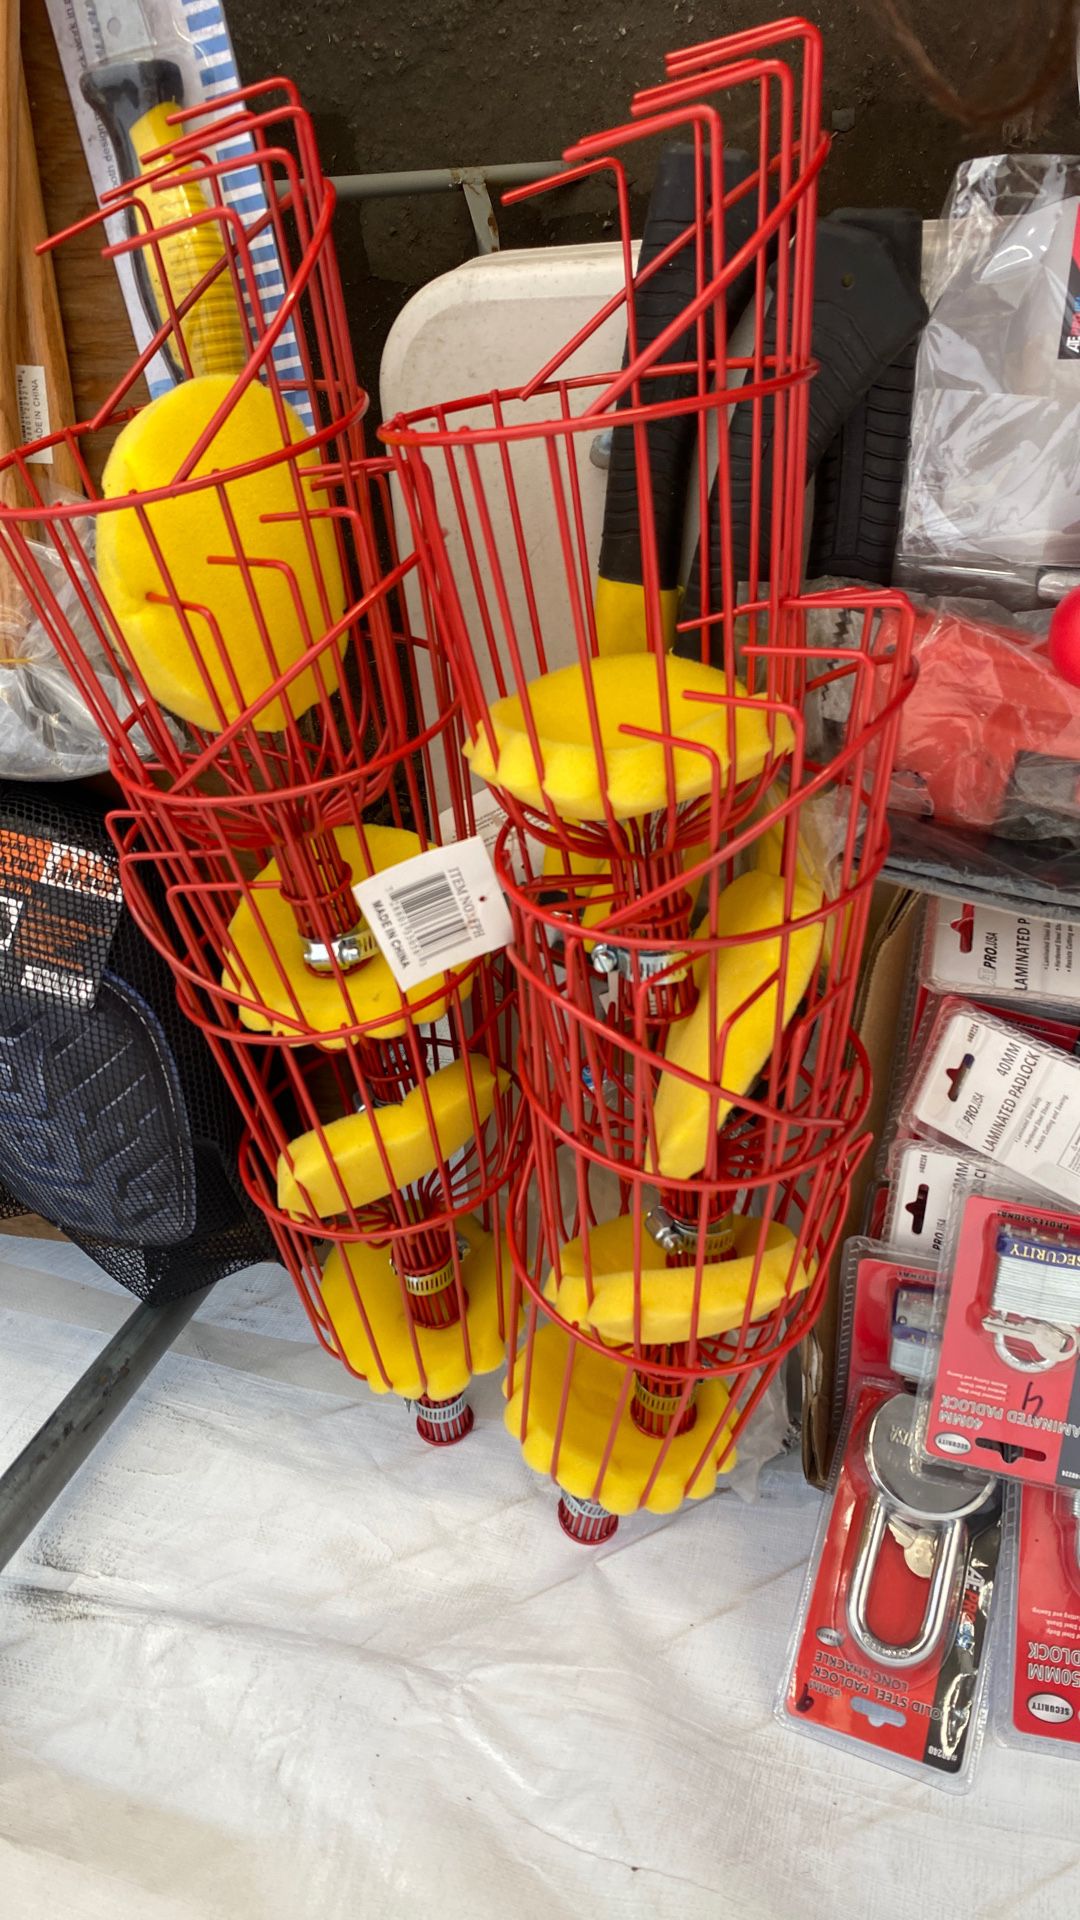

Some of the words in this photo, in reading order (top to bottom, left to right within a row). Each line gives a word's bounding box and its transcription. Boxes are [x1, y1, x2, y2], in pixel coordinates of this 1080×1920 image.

[32, 379, 41, 408] CHINA
[34, 411, 42, 420] IN
[448, 867, 468, 896] ITEM
[372, 900, 393, 929] MADE
[385, 926, 398, 940] IN
[391, 939, 411, 969] CHINA
[1014, 927, 1031, 991] LAMINATED
[996, 1042, 1021, 1077] 40MM
[982, 1098, 1017, 1153] LAMINATED
[1008, 1050, 1041, 1099] PADLOCK
[938, 1410, 983, 1430] 40MM
[941, 1394, 1004, 1420] PADLOCK
[938, 1438, 969, 1450] SECURITY
[815, 1651, 871, 1680] SHACKLE
[1027, 1662, 1080, 1688] 50MM
[812, 1664, 870, 1695] PADLOCK
[873, 1671, 909, 1692] LONG
[873, 1687, 909, 1708] STEEL
[910, 1700, 944, 1720] OLID
[1031, 1702, 1071, 1716] SECURITY
